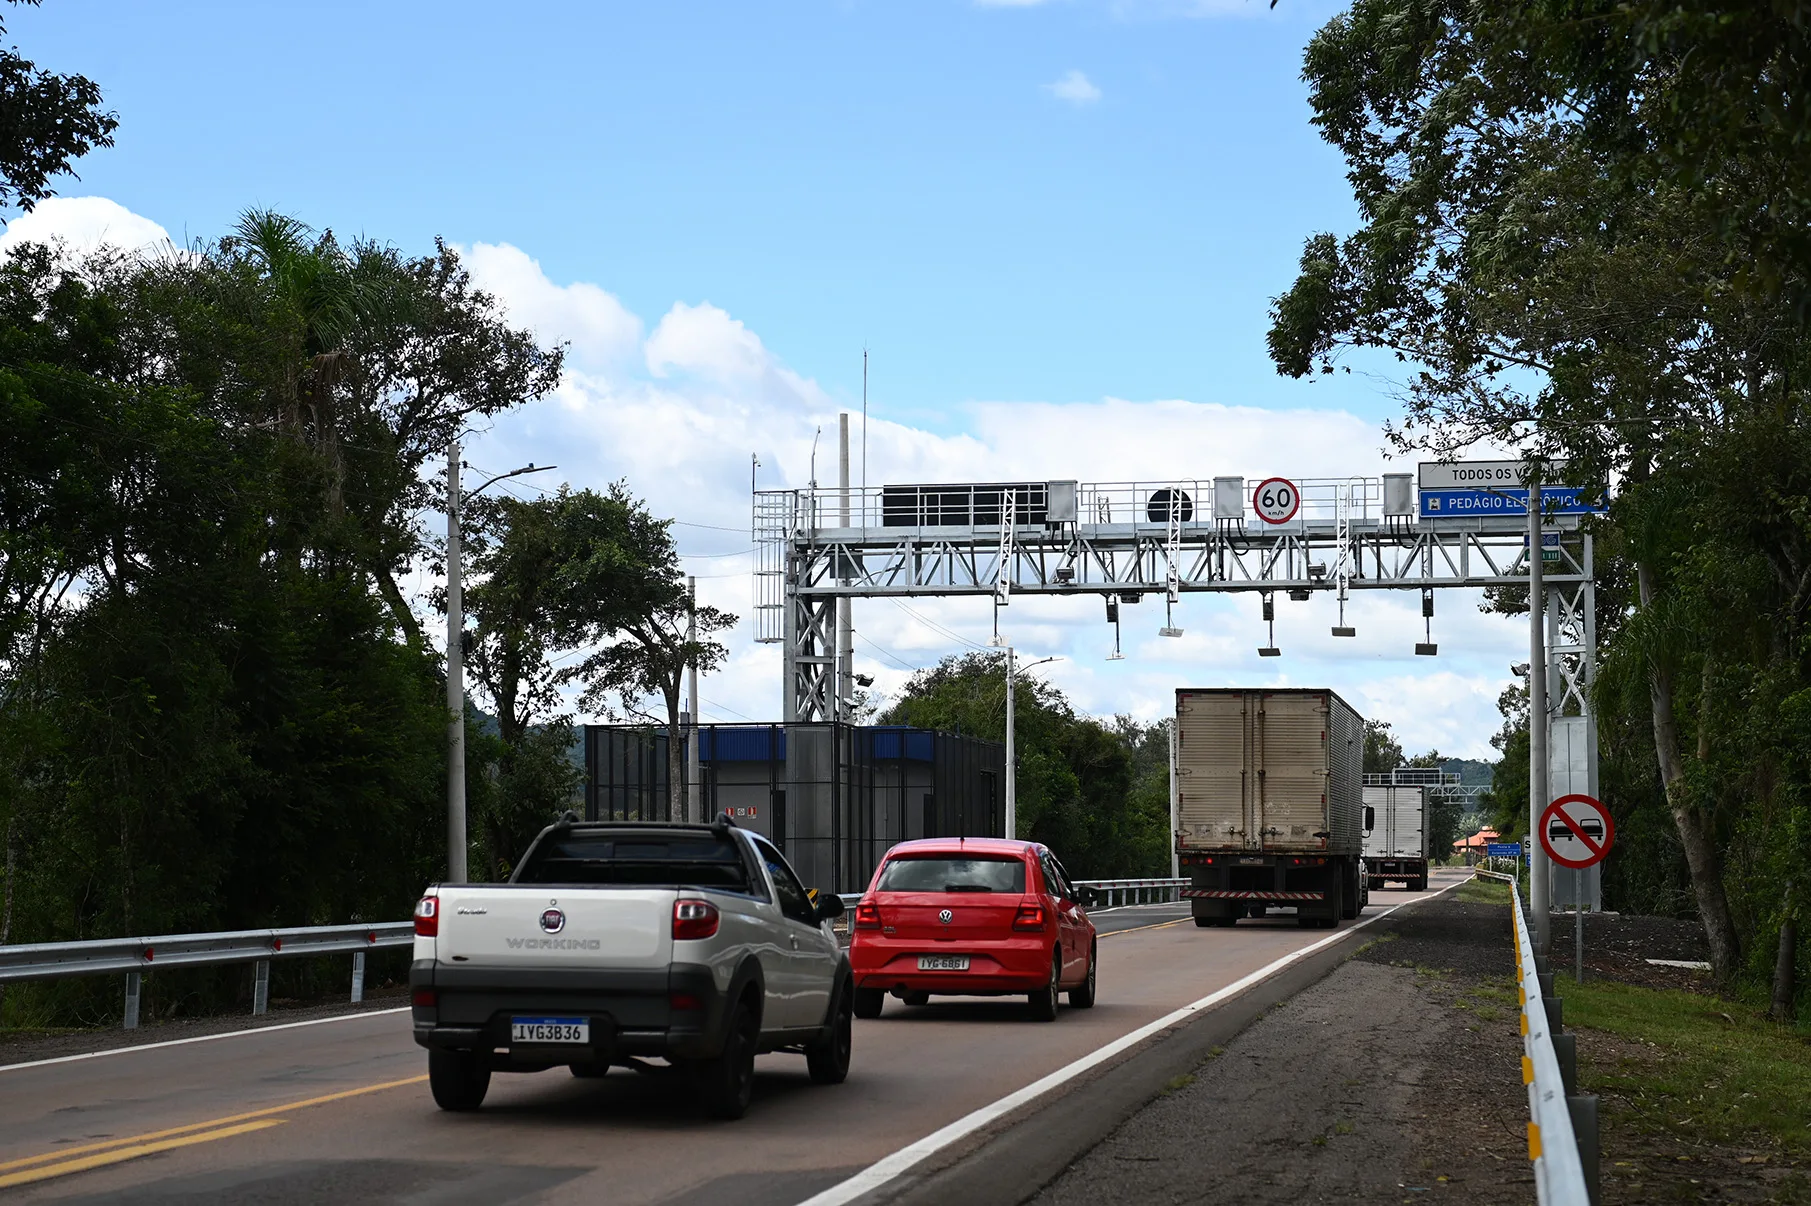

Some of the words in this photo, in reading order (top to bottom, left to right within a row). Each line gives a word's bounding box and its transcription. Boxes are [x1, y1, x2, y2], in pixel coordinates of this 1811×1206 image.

[1452, 468, 1493, 480] TODOS
[1495, 468, 1512, 480] OS
[1262, 488, 1290, 508] 60
[1449, 494, 1502, 509] PEDÁGIO
[1505, 492, 1581, 508] ELEÔNICO
[506, 938, 601, 950] WORKING
[518, 1025, 581, 1041] IYG3B36
